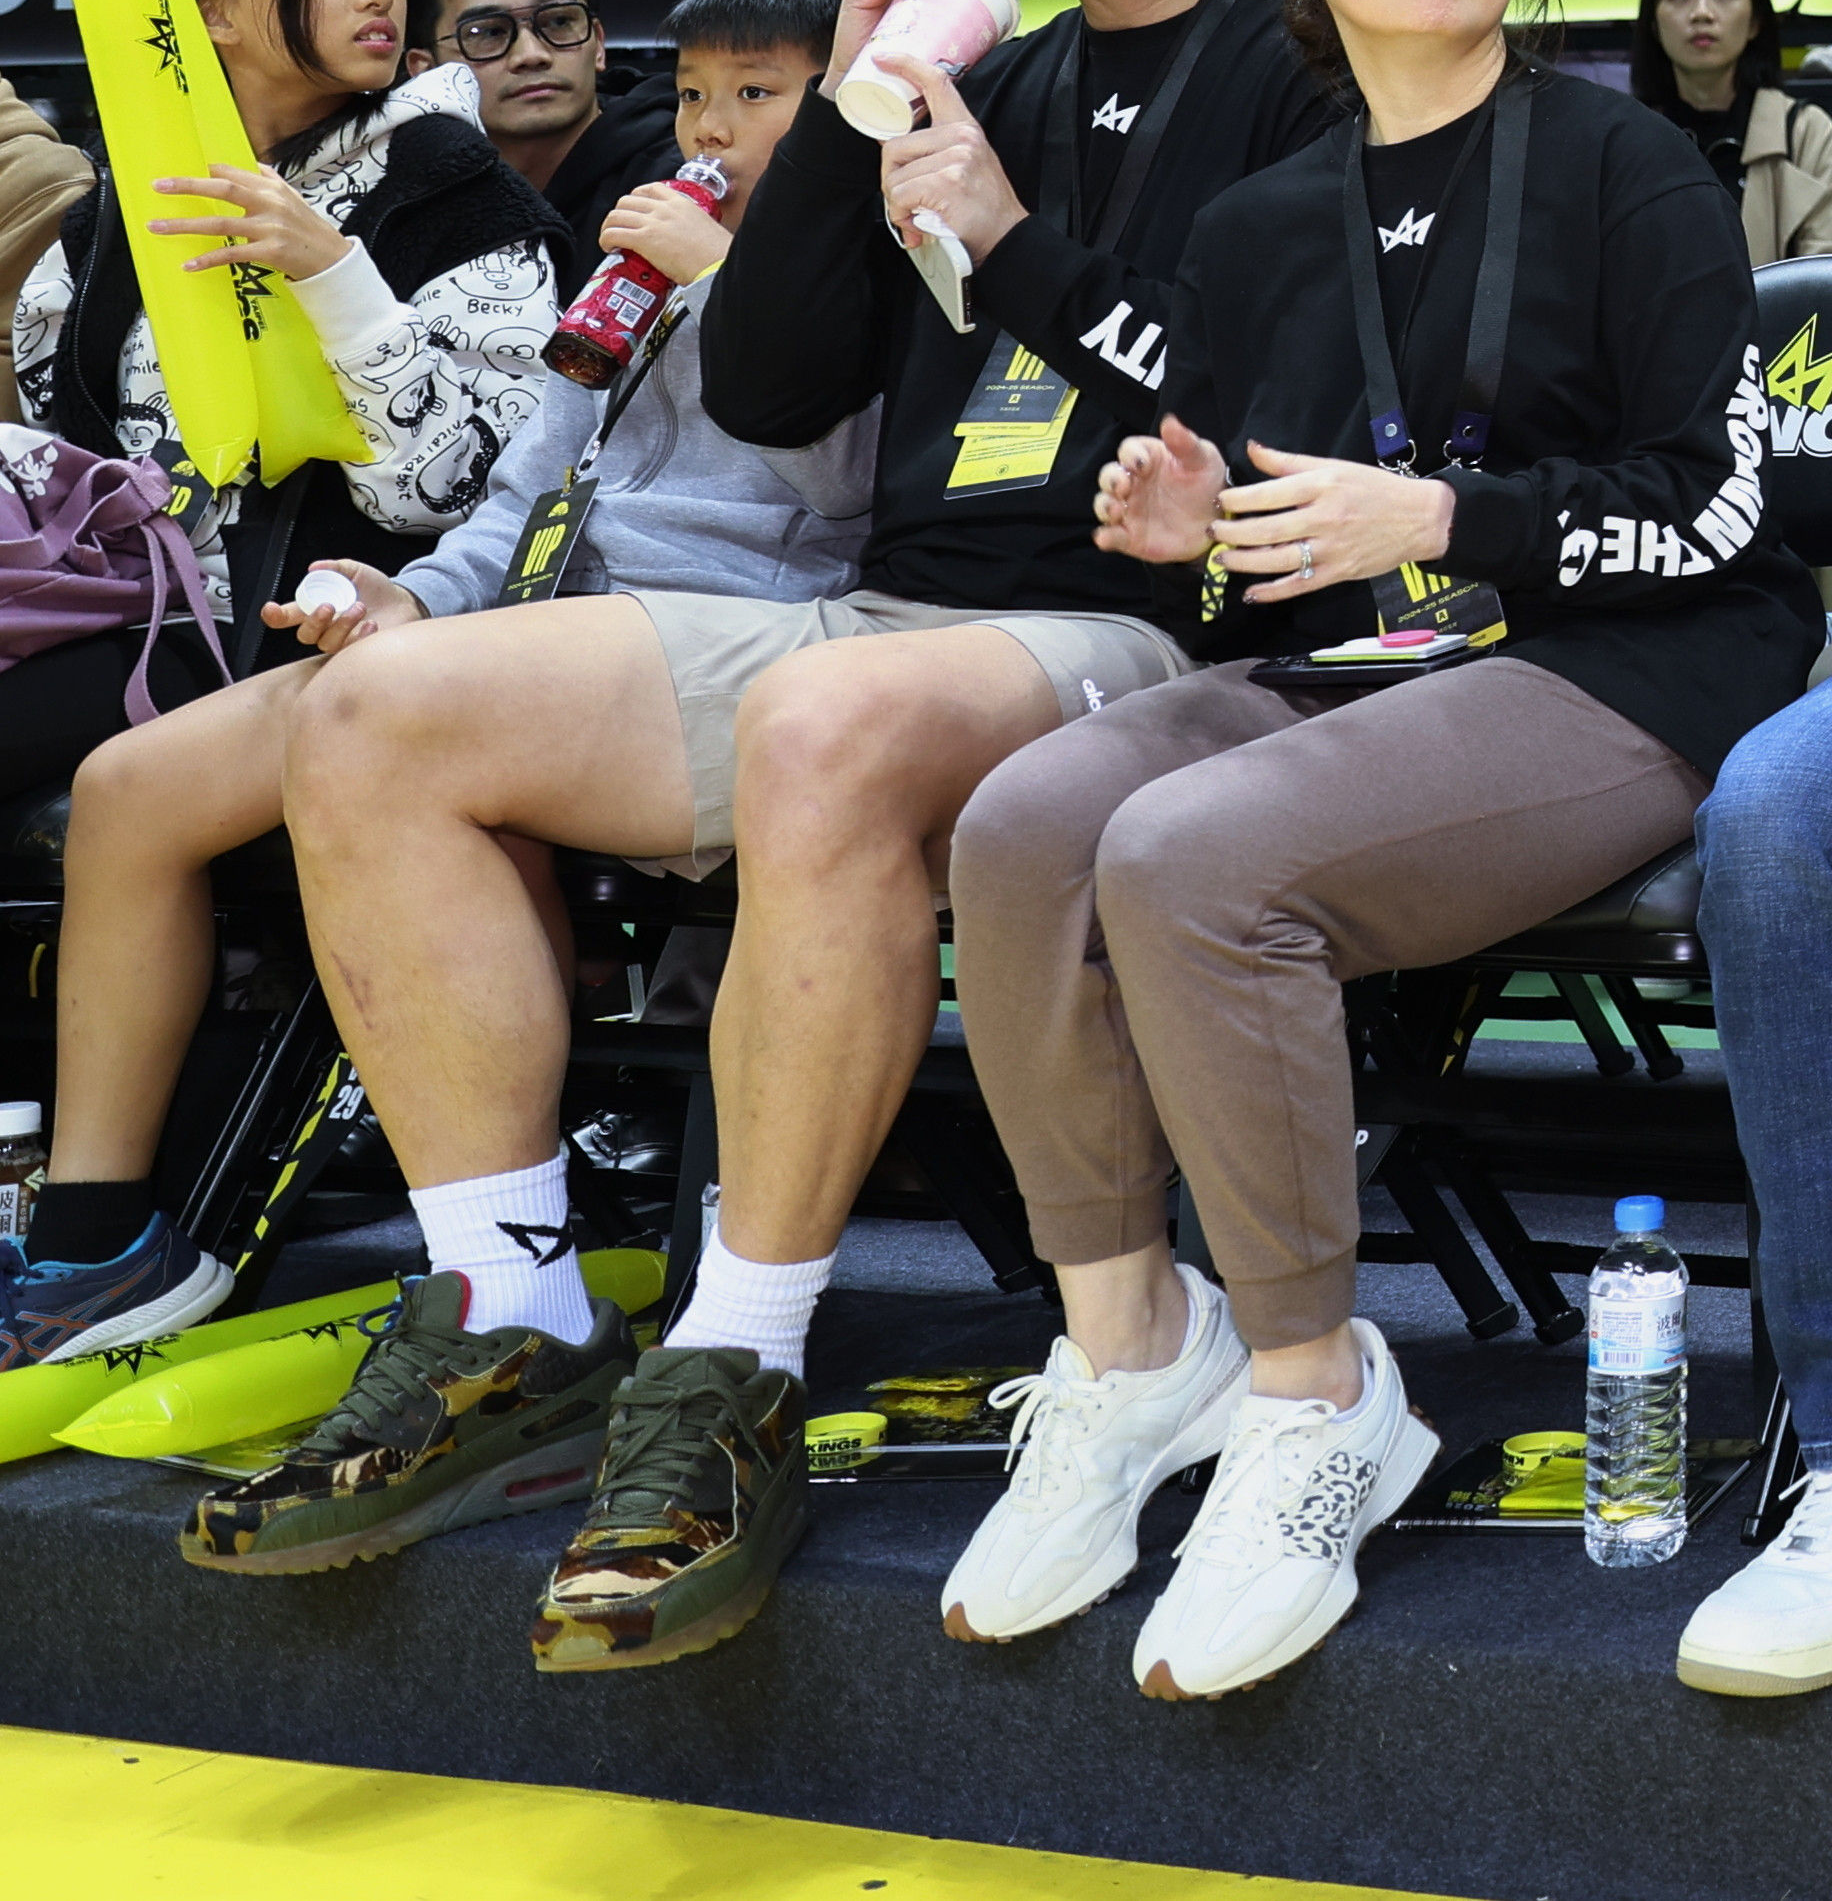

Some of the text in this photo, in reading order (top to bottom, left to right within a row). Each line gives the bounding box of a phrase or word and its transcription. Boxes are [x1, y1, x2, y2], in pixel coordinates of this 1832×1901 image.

[466, 299, 524, 317] Becky
[396, 452, 426, 501] Rabbit
[162, 484, 192, 517] IP
[521, 523, 566, 577] VIP
[1601, 516, 1716, 577] THE
[1397, 581, 1479, 623] 2024-25 SEASON
[328, 1084, 365, 1120] 29
[806, 1439, 862, 1453] KINGS
